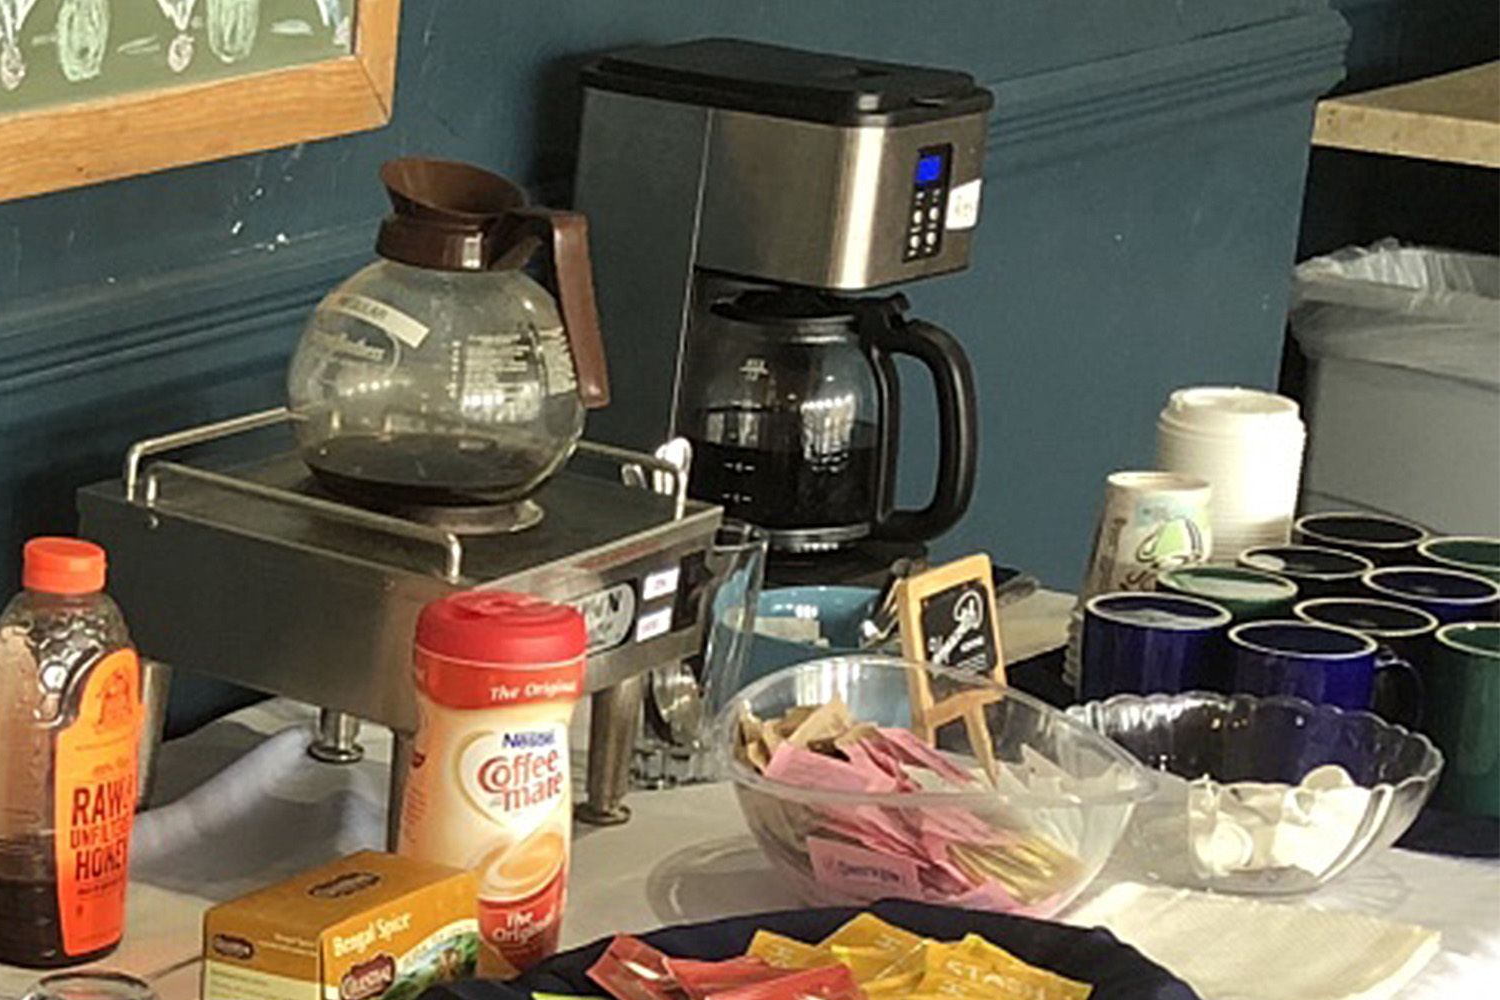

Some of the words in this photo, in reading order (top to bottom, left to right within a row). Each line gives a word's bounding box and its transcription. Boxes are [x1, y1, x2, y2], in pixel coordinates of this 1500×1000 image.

[489, 684, 519, 701] The
[524, 679, 578, 698] Original
[476, 749, 560, 795] Coffee
[502, 770, 564, 812] mate
[71, 780, 122, 827] RAW
[332, 924, 376, 958] Bengal
[377, 911, 412, 941] Spice
